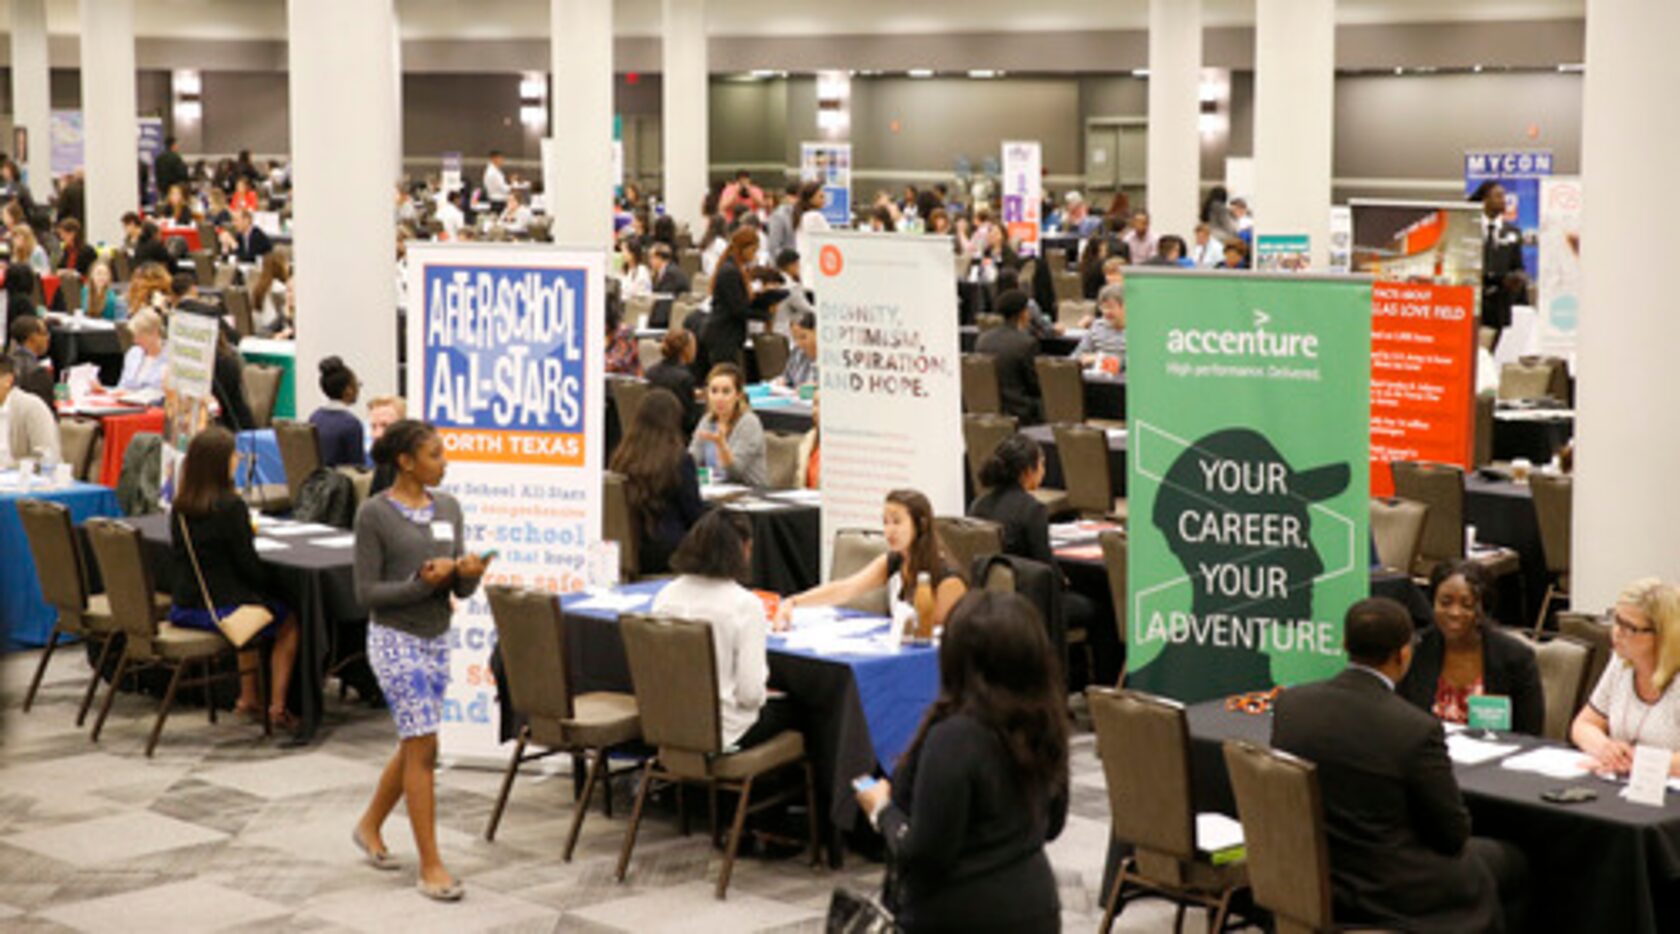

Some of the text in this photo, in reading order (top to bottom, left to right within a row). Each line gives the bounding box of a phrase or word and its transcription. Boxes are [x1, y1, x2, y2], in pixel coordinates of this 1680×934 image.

[1467, 155, 1551, 172] MYCON
[1400, 303, 1429, 319] LOVE
[1434, 305, 1466, 321] FIELD
[1166, 325, 1319, 358] accenture
[824, 371, 930, 398] AND HOPE.
[443, 433, 580, 457] ORTH TEXAS
[1200, 459, 1288, 495] YOUR
[1178, 510, 1309, 549] CAREER.
[1200, 562, 1288, 599] YOUR
[1145, 611, 1343, 656] ADVENTURE.
[442, 692, 490, 724] nd
